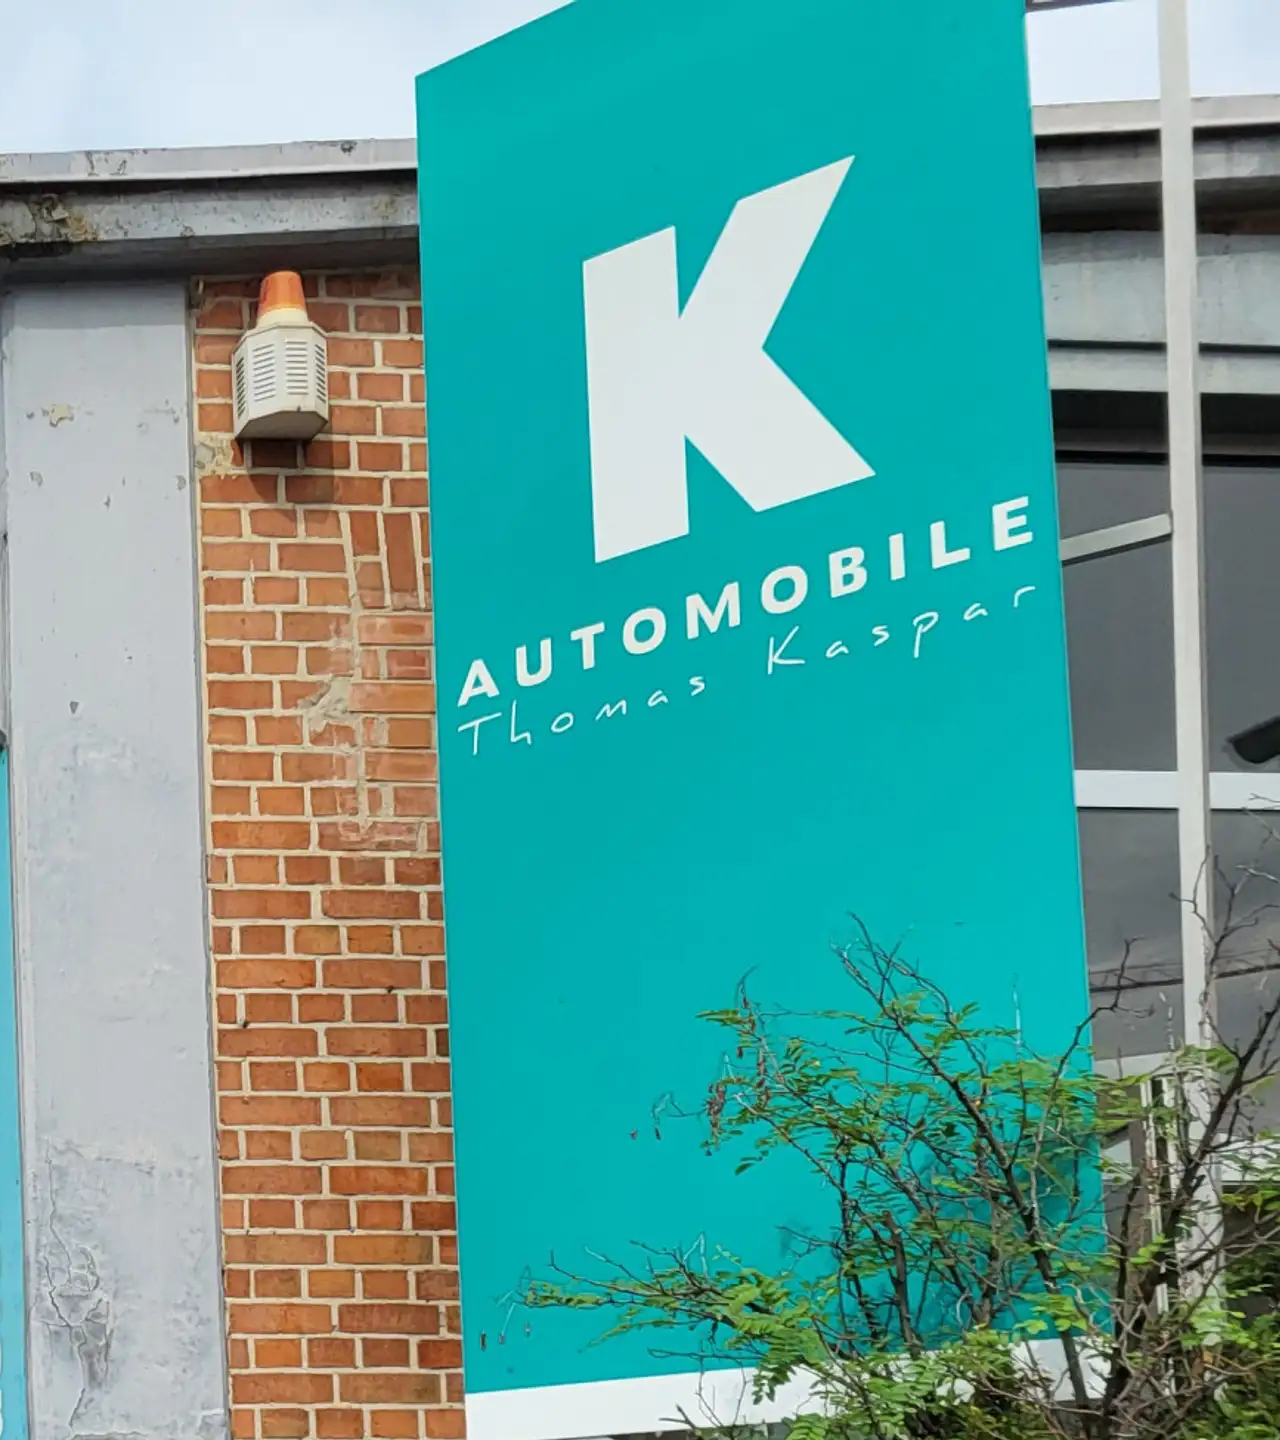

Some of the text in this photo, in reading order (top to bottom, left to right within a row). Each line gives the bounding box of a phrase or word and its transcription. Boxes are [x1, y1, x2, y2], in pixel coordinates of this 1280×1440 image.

[582, 155, 876, 563] K
[456, 585, 1036, 757] Thomas Kaspar
[457, 496, 1034, 707] AUTOMOBILE
